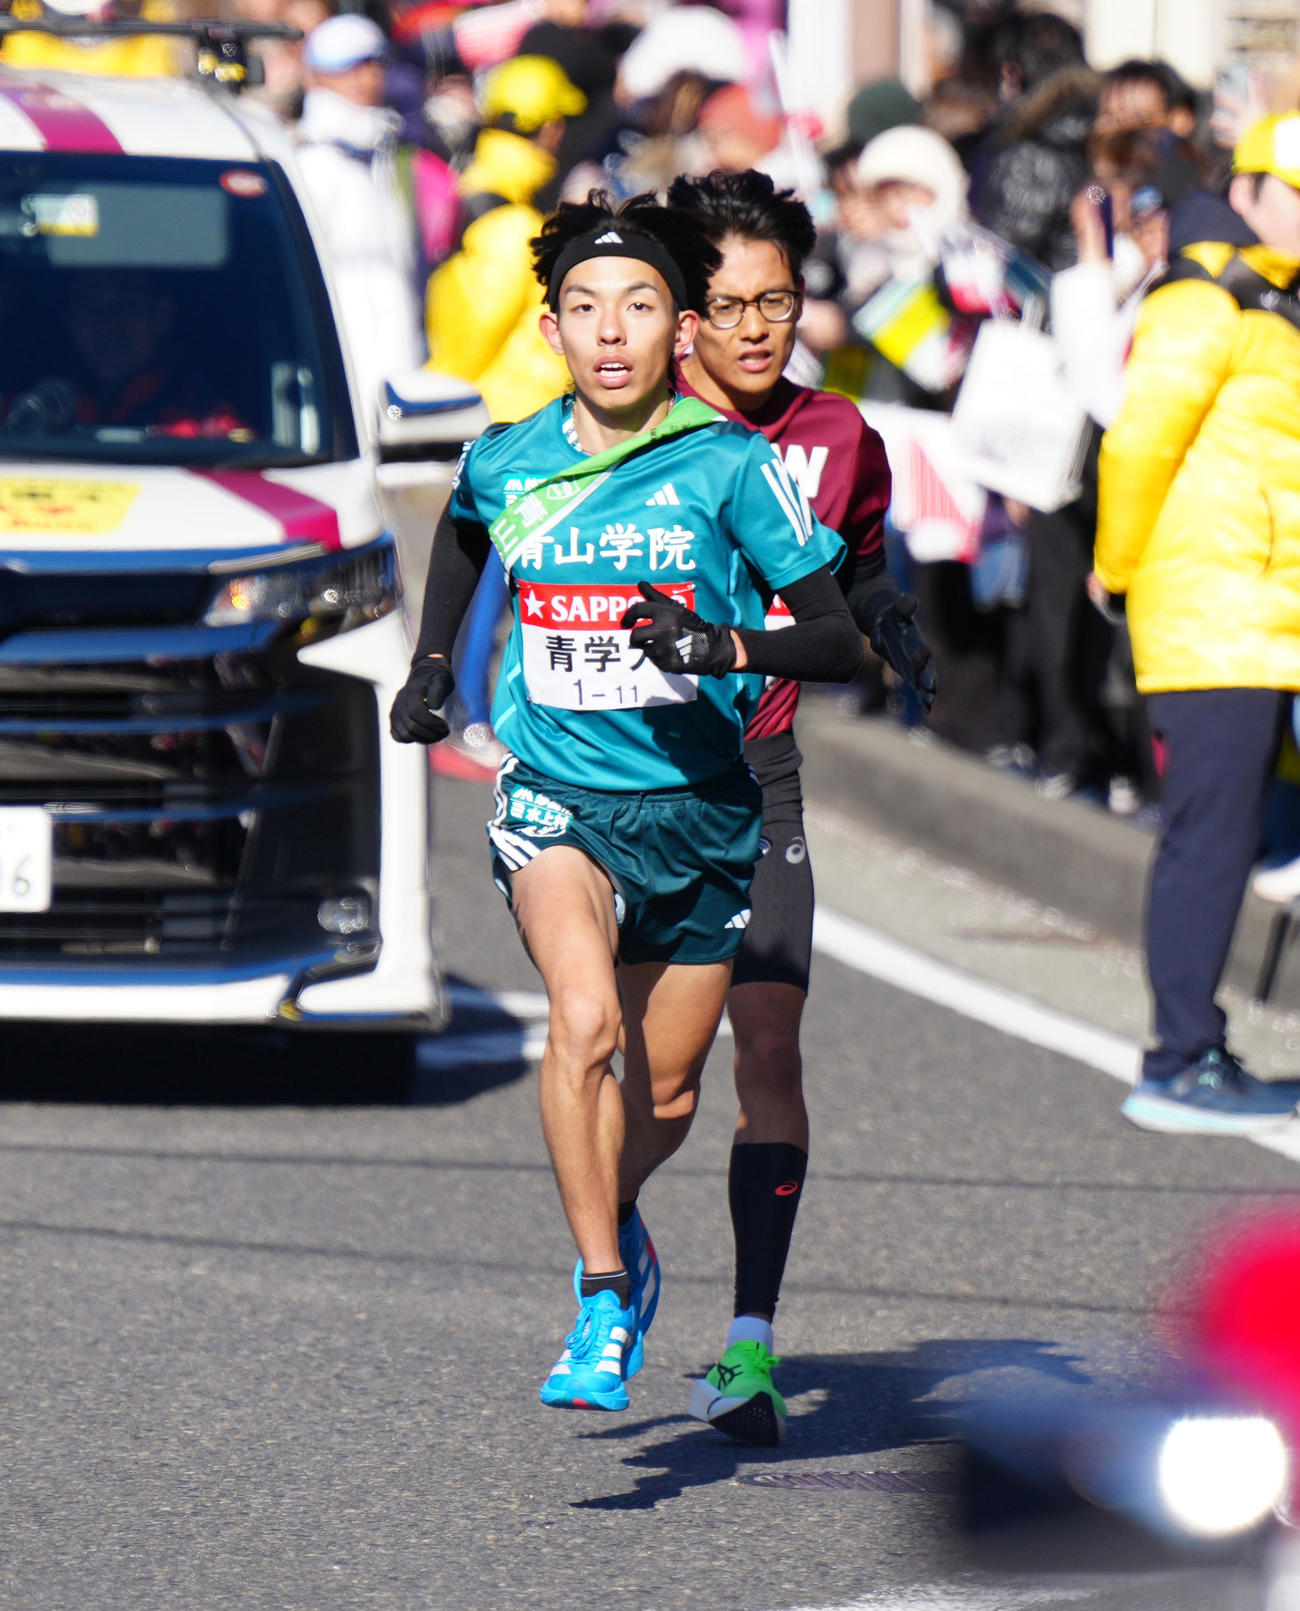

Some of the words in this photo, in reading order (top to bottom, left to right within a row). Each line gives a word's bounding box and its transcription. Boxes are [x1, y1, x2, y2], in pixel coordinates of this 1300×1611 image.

[770, 443, 829, 498] W
[551, 595, 687, 623] SAPP
[545, 635, 645, 673] 青学
